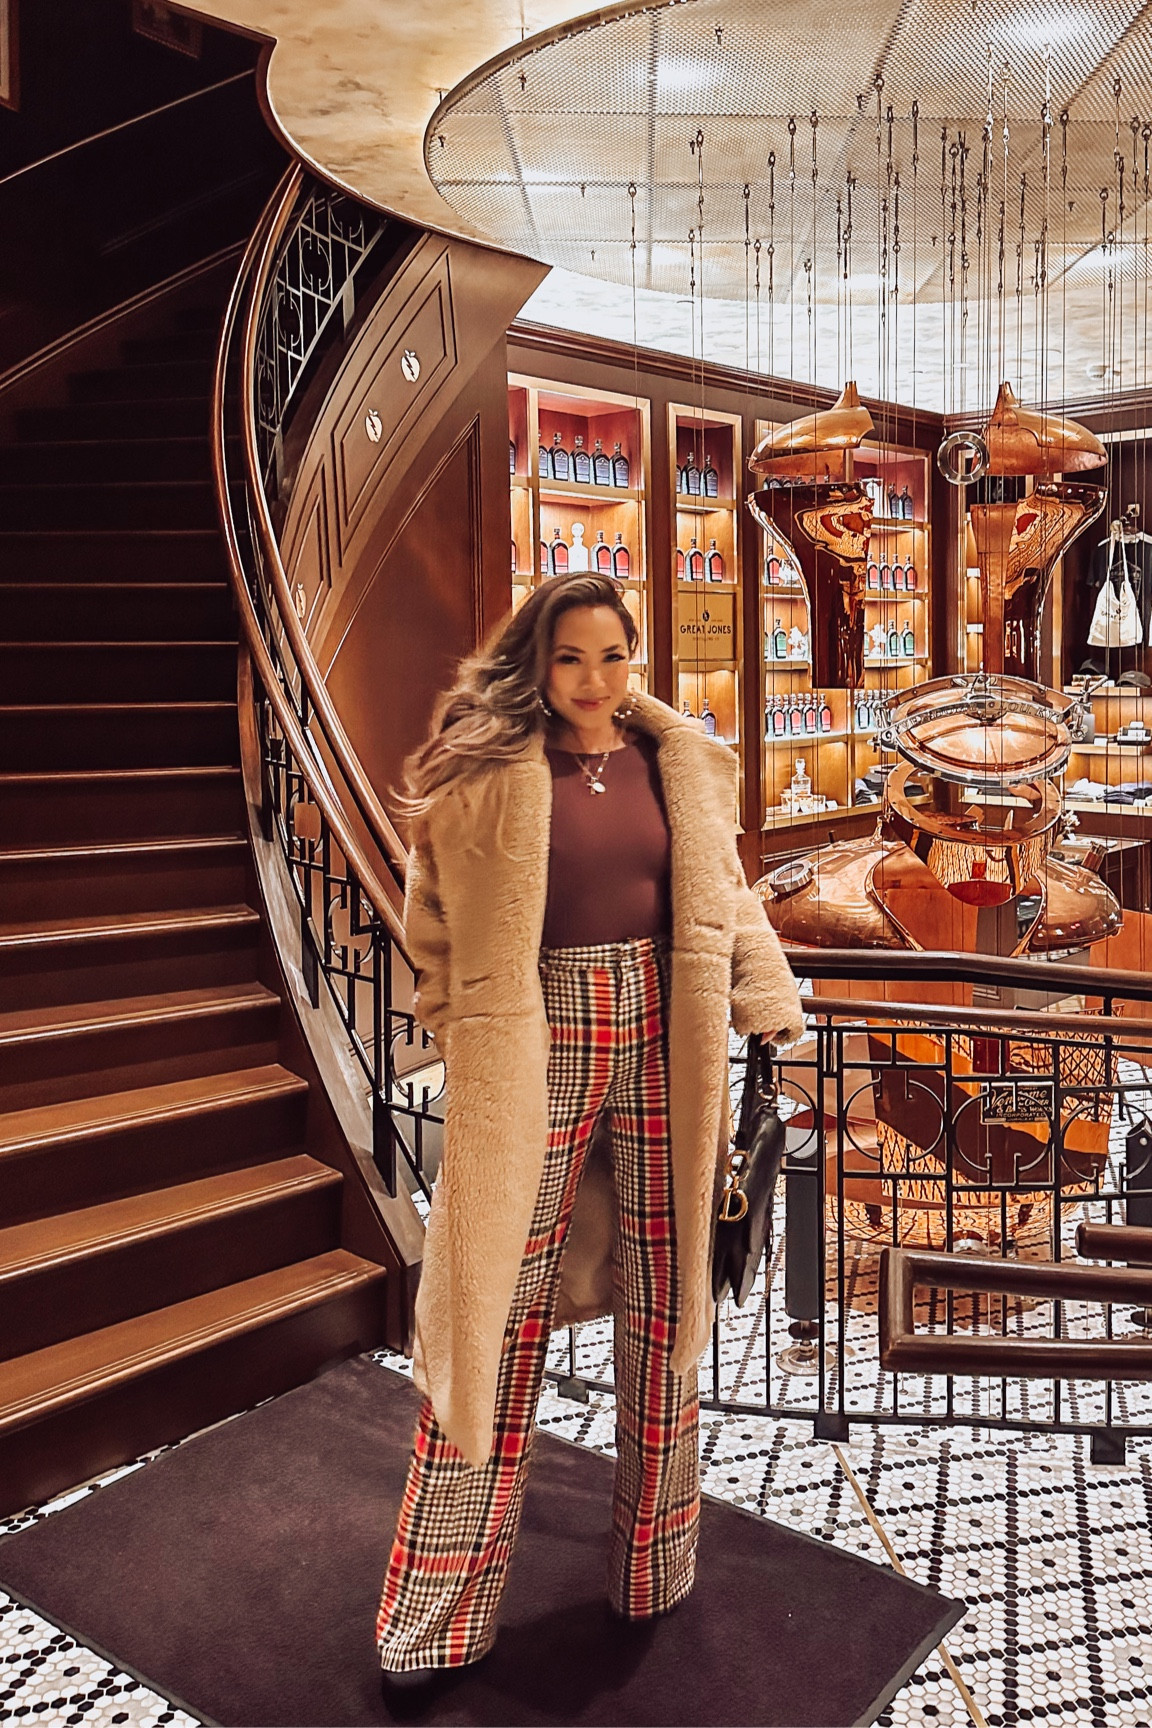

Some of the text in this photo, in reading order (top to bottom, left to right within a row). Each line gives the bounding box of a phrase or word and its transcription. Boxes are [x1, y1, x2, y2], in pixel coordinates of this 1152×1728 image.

[680, 624, 732, 635] GREAT JONES
[990, 1088, 1048, 1109] Venme
